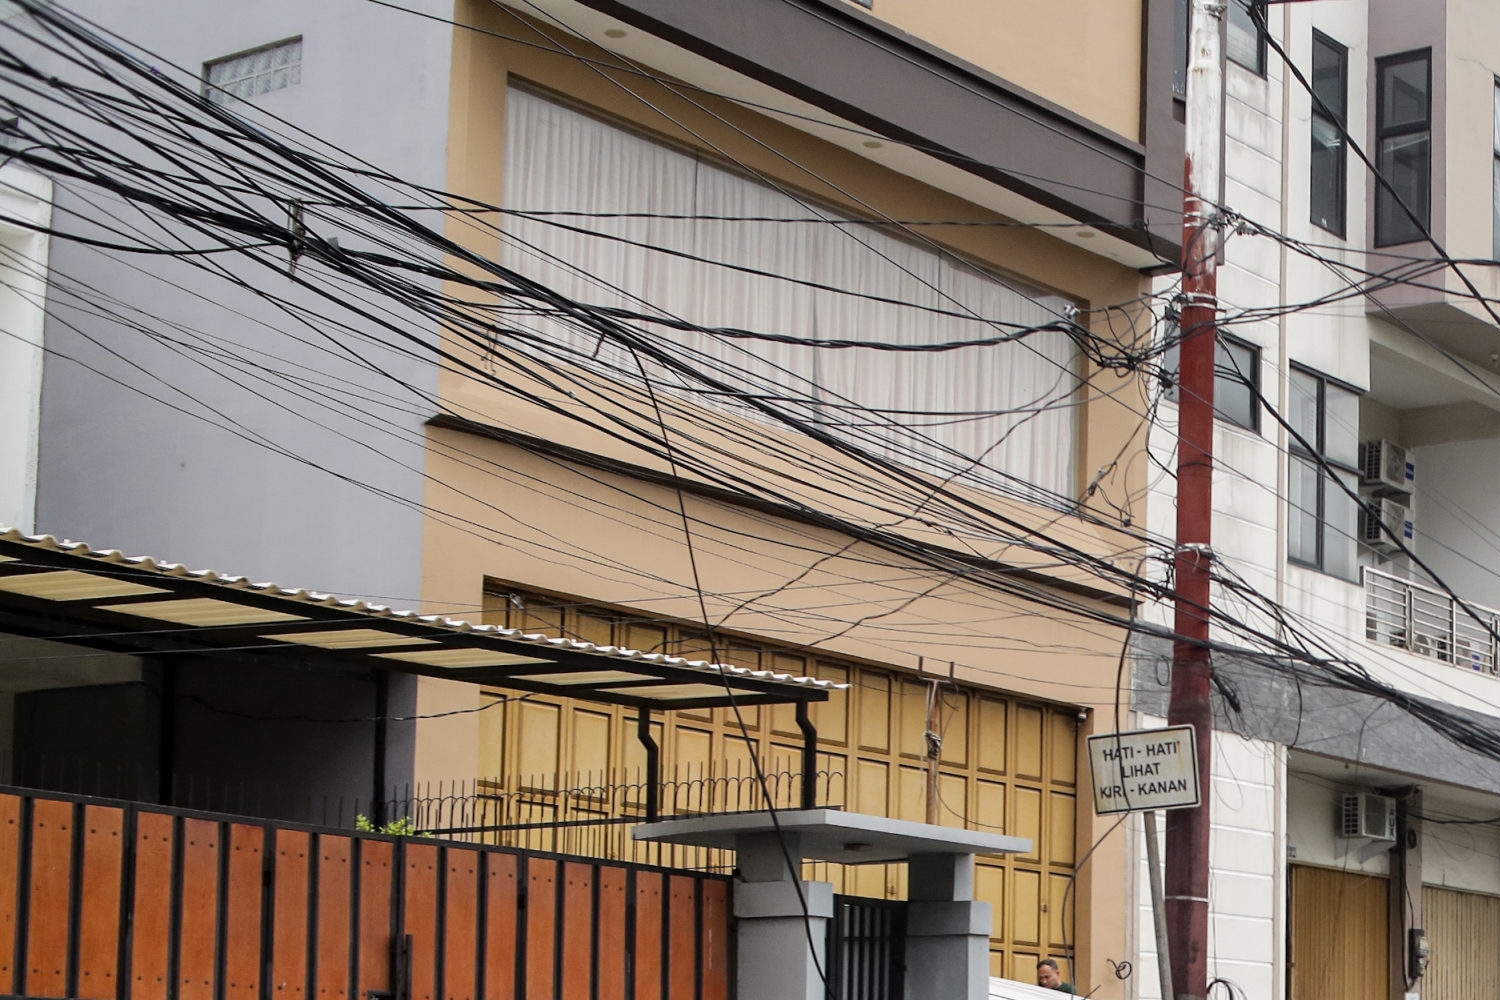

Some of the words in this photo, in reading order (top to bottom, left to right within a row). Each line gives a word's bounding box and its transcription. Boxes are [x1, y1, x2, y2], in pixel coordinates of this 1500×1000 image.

[1104, 746, 1134, 761] HATI
[1146, 741, 1177, 757] HATI
[1121, 762, 1160, 778] LIHAT
[1138, 778, 1187, 796] KANAN
